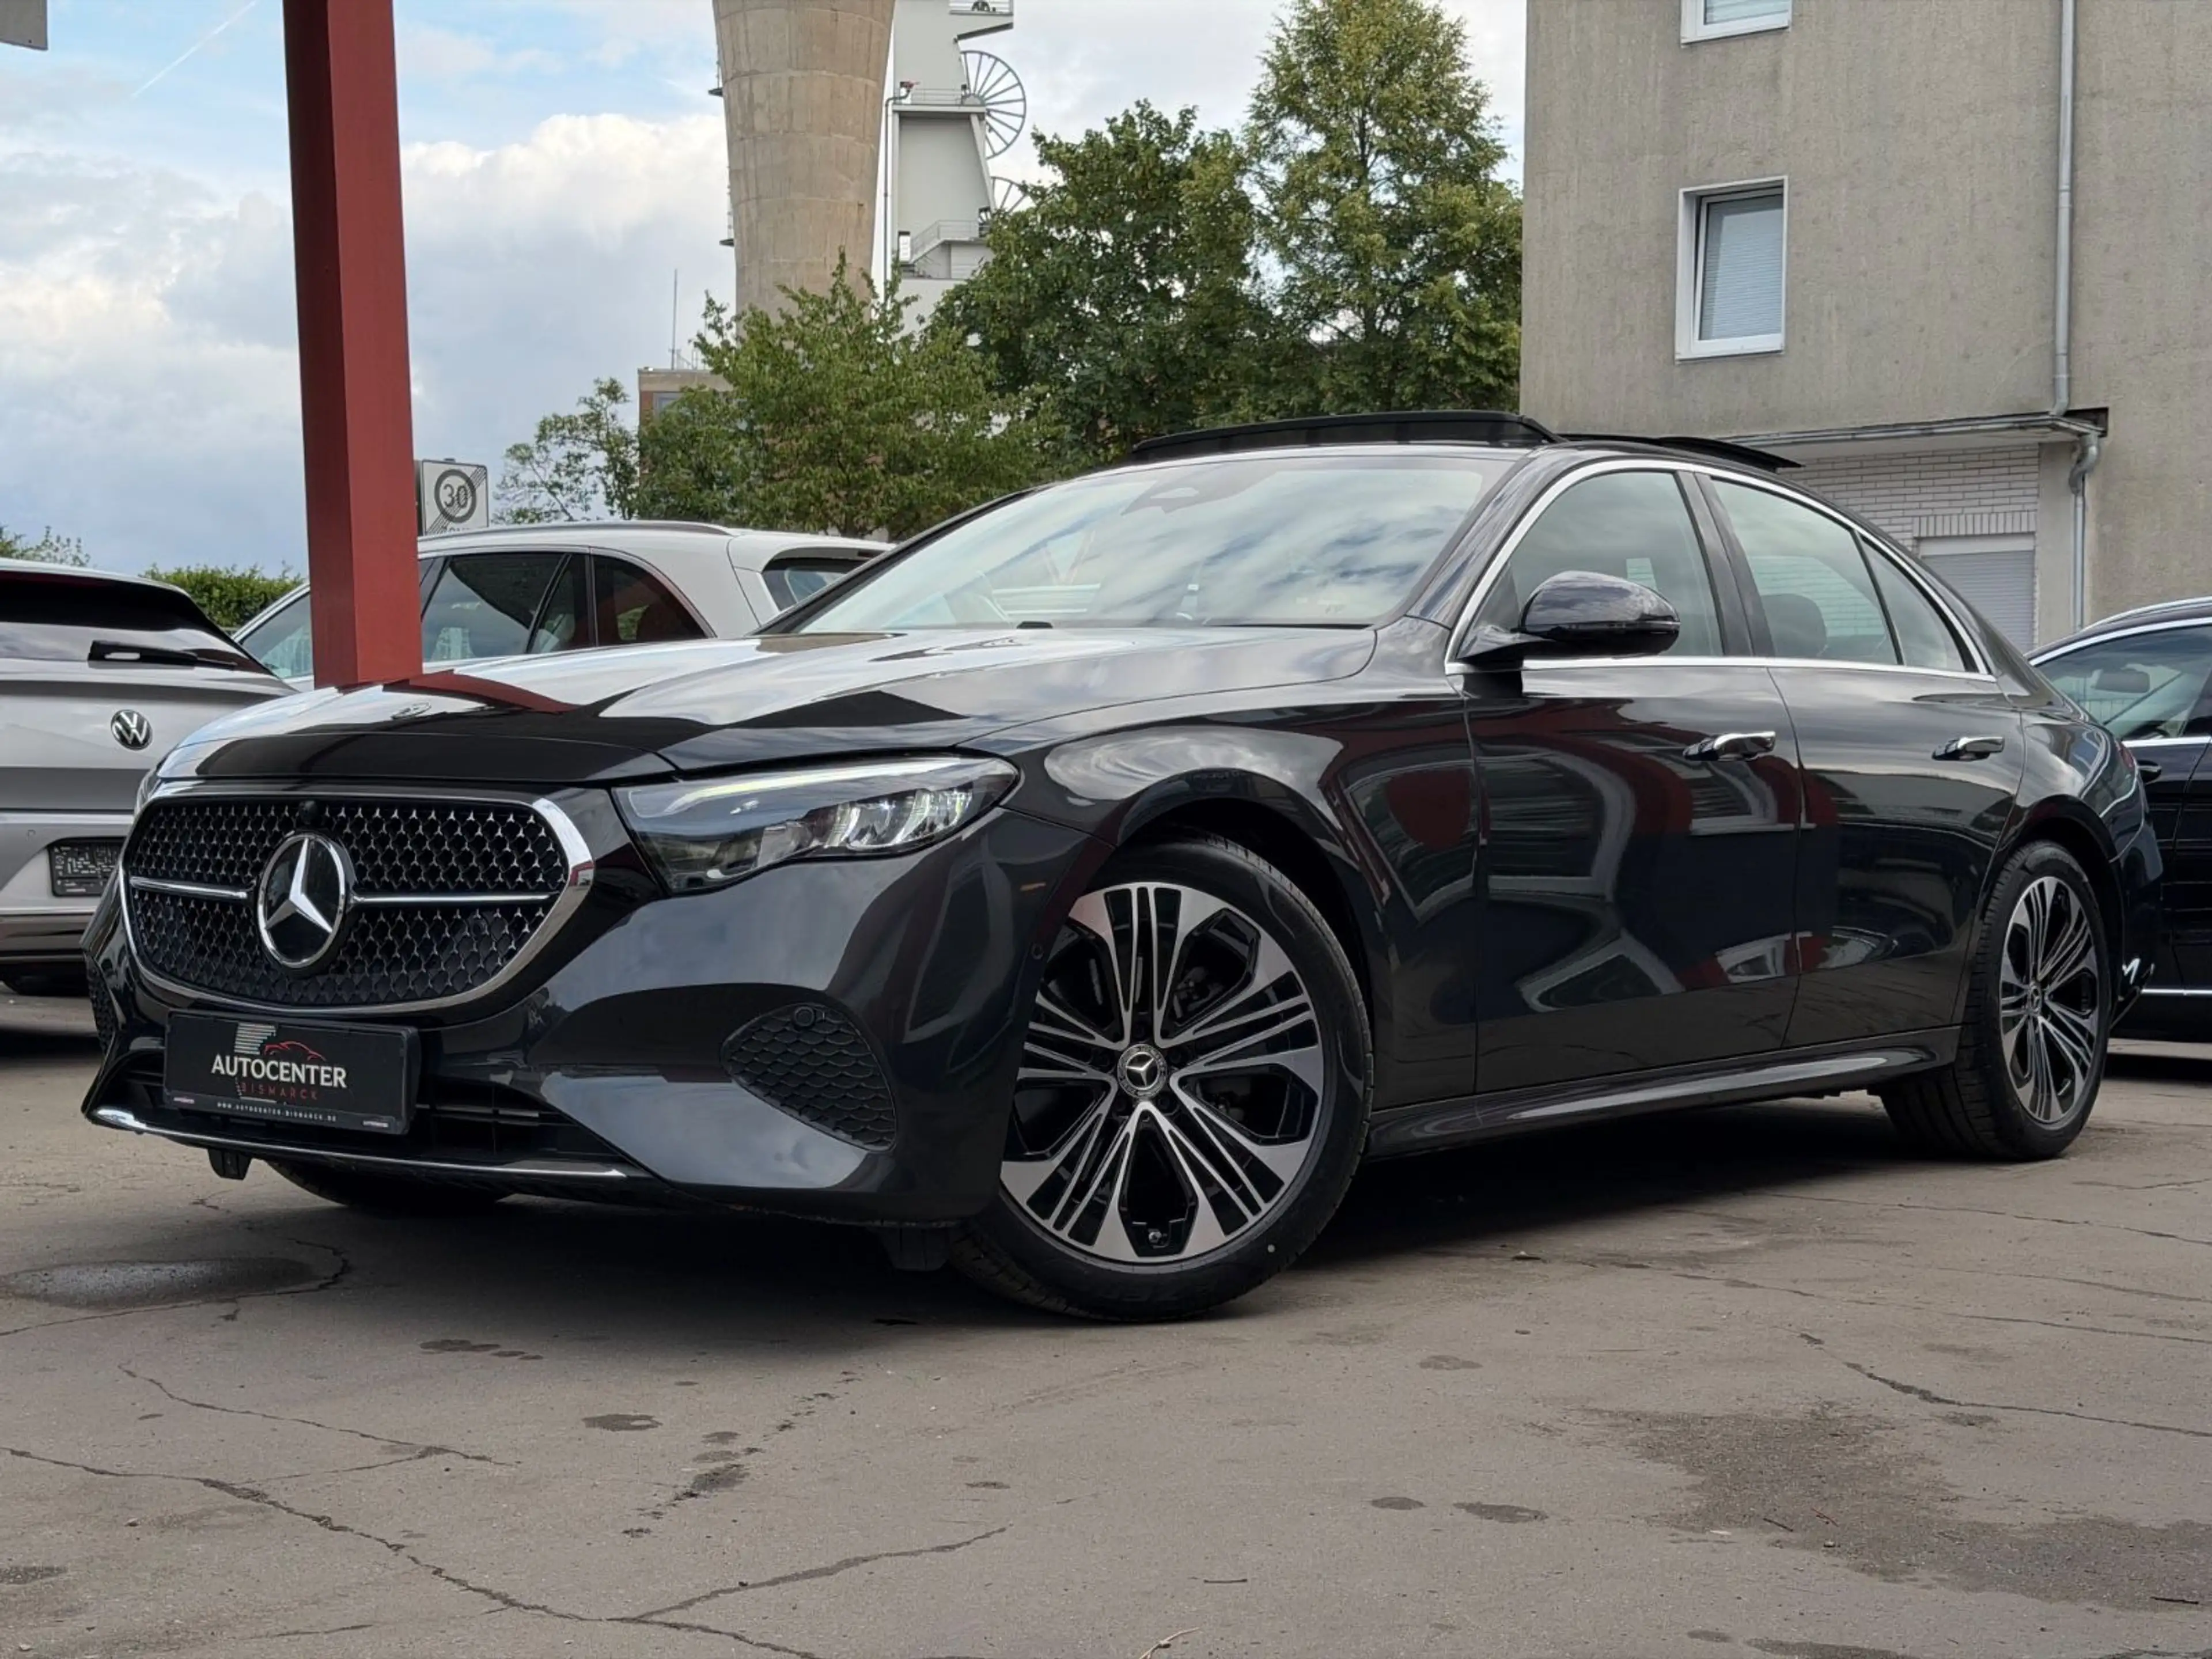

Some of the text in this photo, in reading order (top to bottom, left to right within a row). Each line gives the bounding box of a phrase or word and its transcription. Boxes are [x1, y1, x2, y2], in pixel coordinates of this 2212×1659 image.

[444, 484, 468, 507] 30
[211, 1054, 347, 1088] AUTOCENTER
[241, 1082, 317, 1100] BISMARCK
